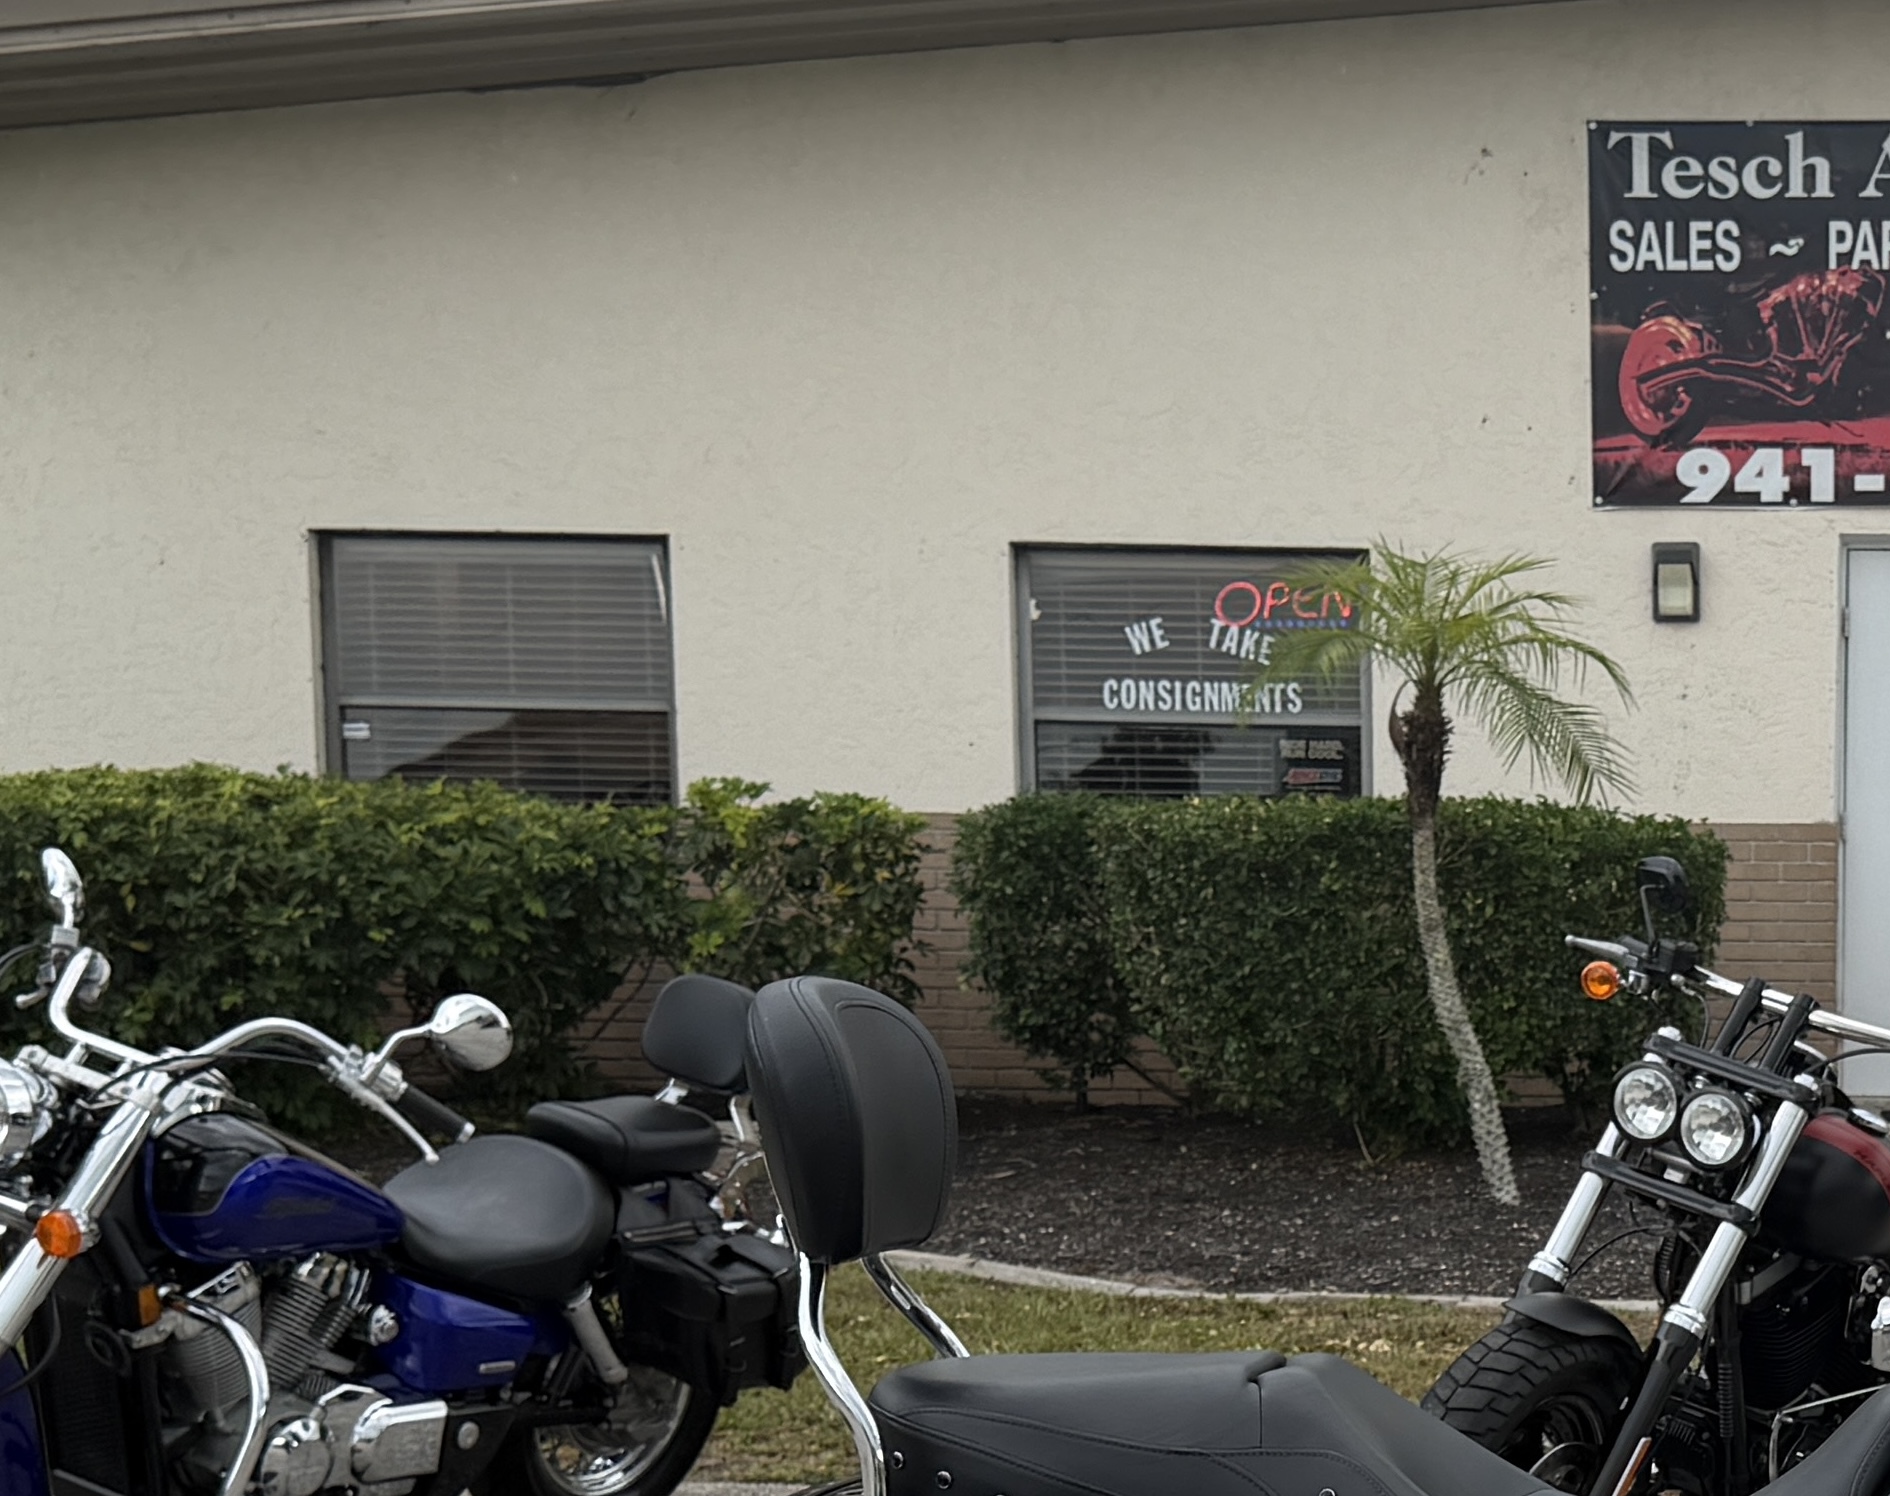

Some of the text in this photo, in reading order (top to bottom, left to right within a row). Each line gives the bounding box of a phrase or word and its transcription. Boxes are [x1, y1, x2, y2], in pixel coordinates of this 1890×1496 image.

[1608, 129, 1834, 199] Tesch
[1608, 218, 1742, 273] SALES
[1124, 617, 1276, 666] WE TAKE
